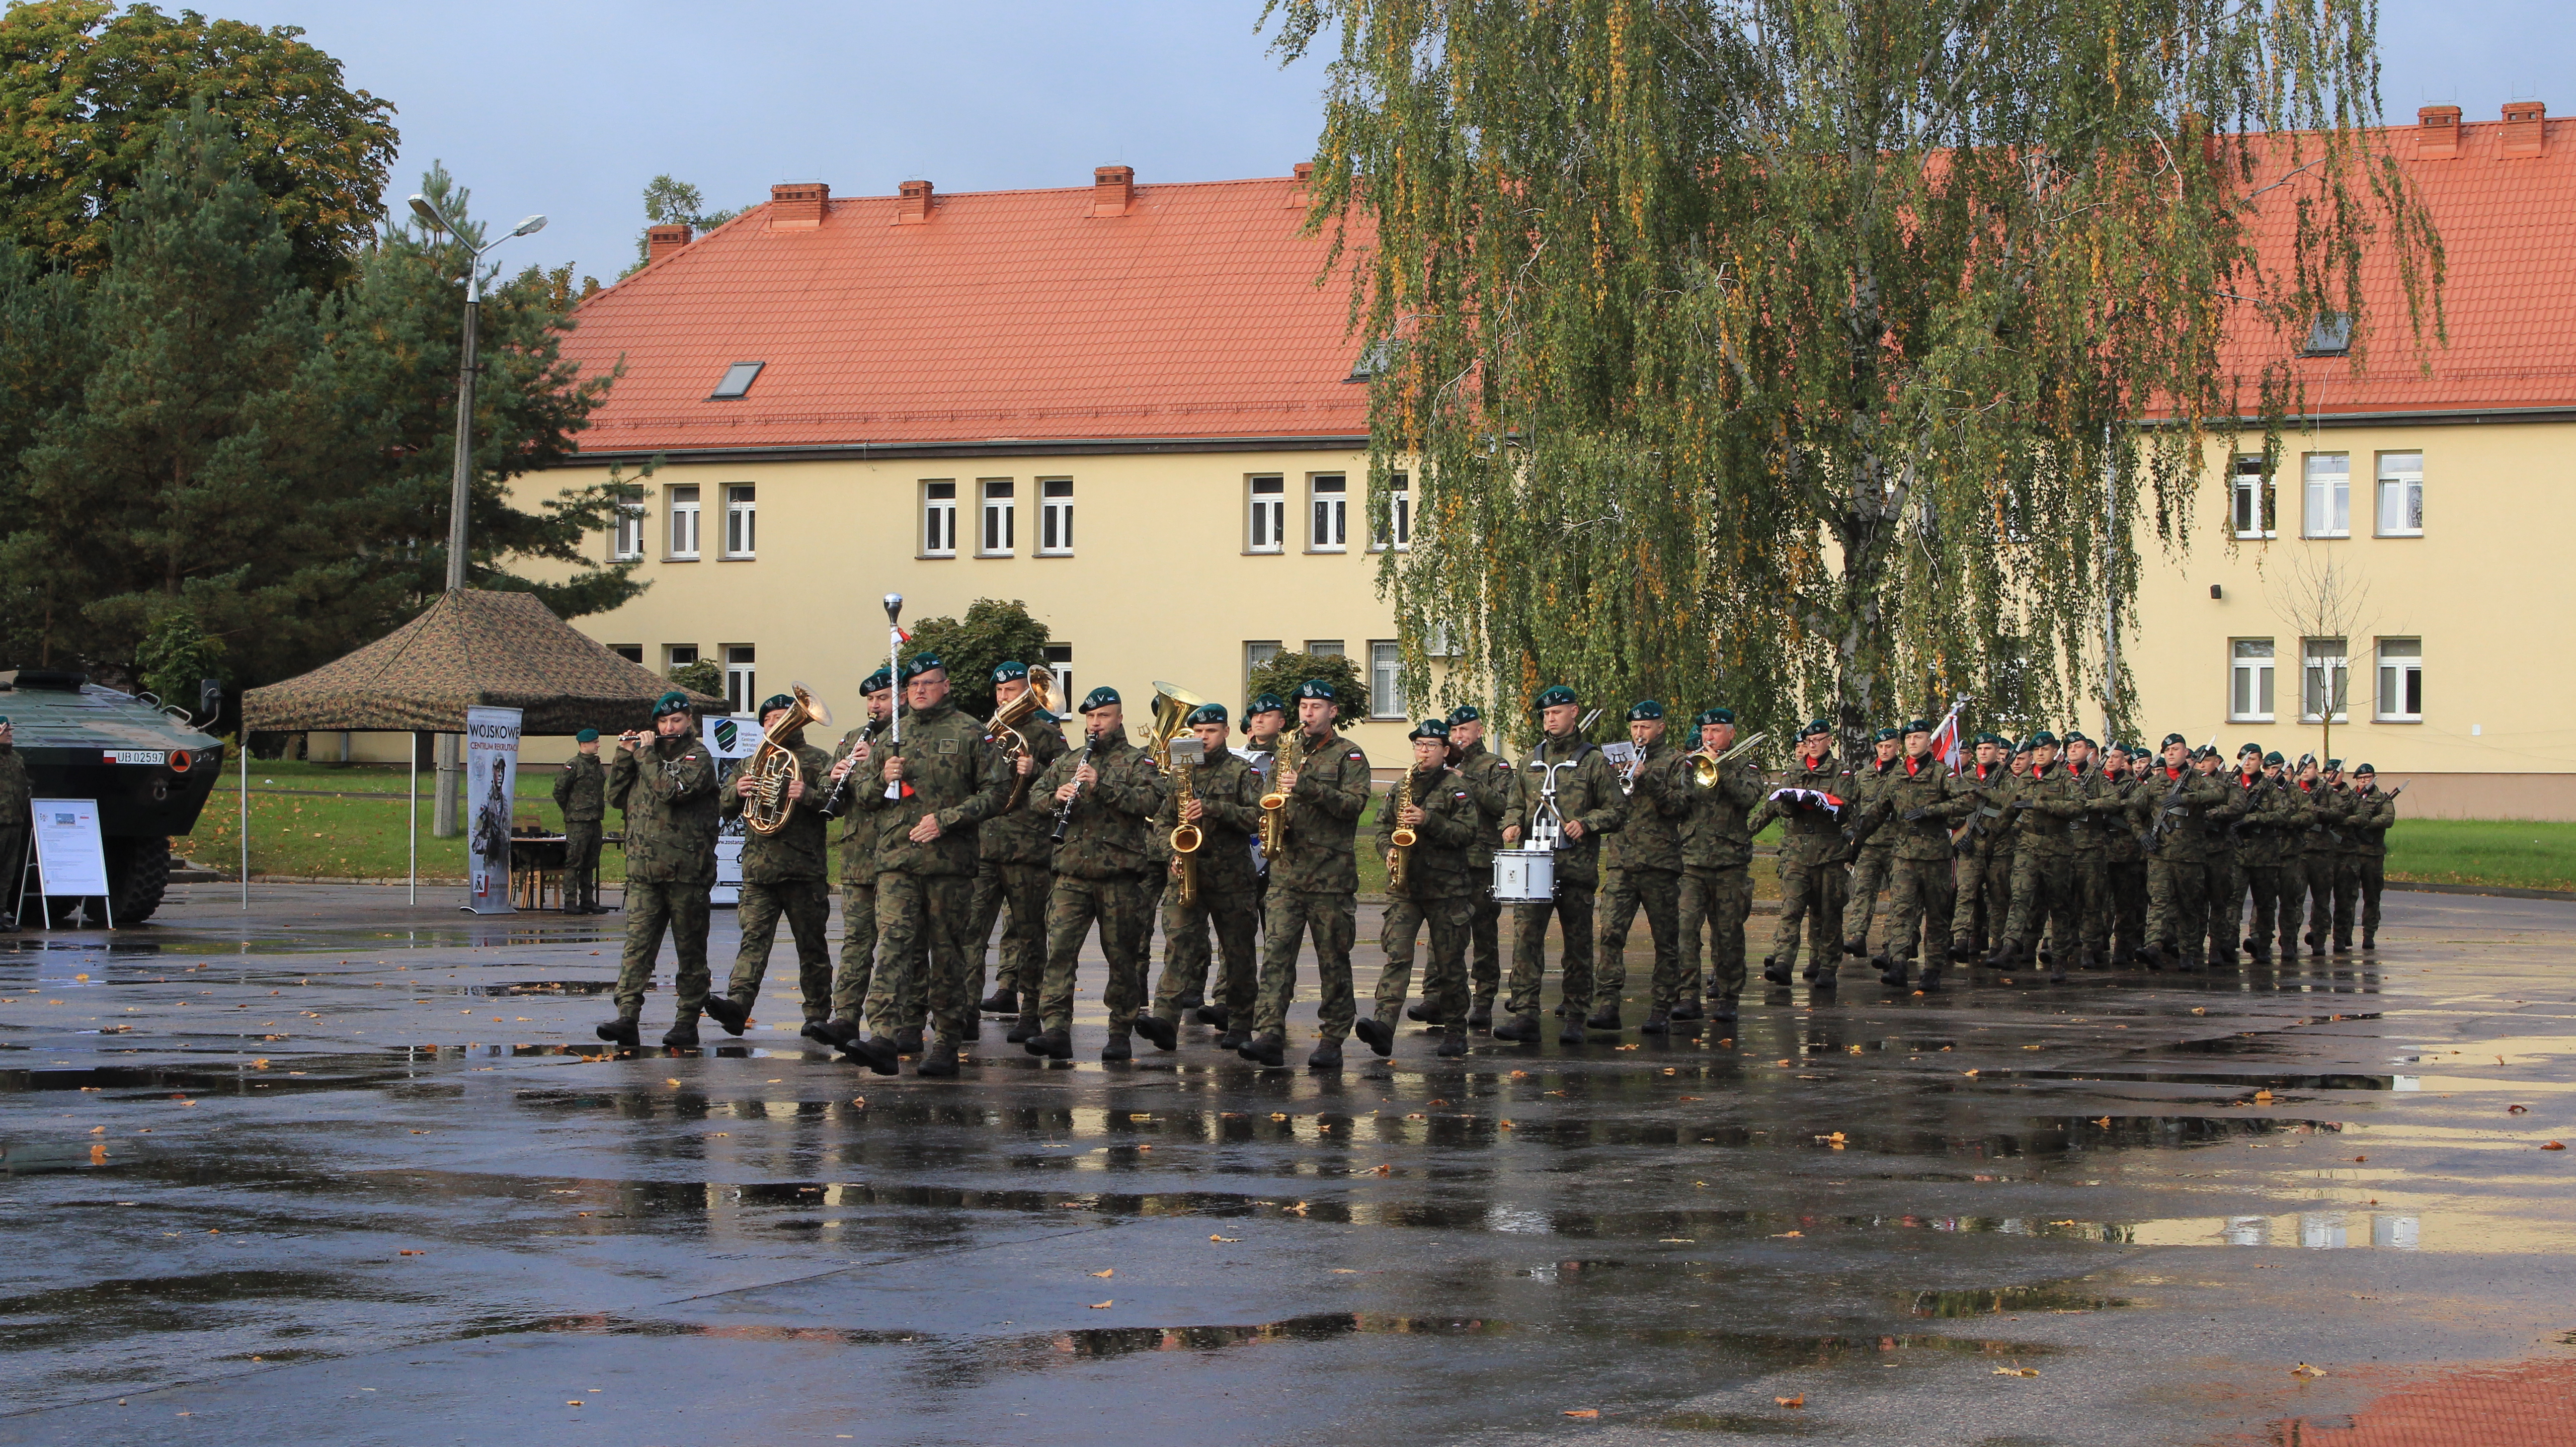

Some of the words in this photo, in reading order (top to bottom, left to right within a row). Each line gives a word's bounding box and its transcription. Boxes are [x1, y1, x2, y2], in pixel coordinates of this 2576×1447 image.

[469, 724, 520, 739] WOJSKOWE
[470, 742, 494, 751] CENTRUM
[118, 752, 131, 762] UB
[134, 752, 163, 763] 02597
